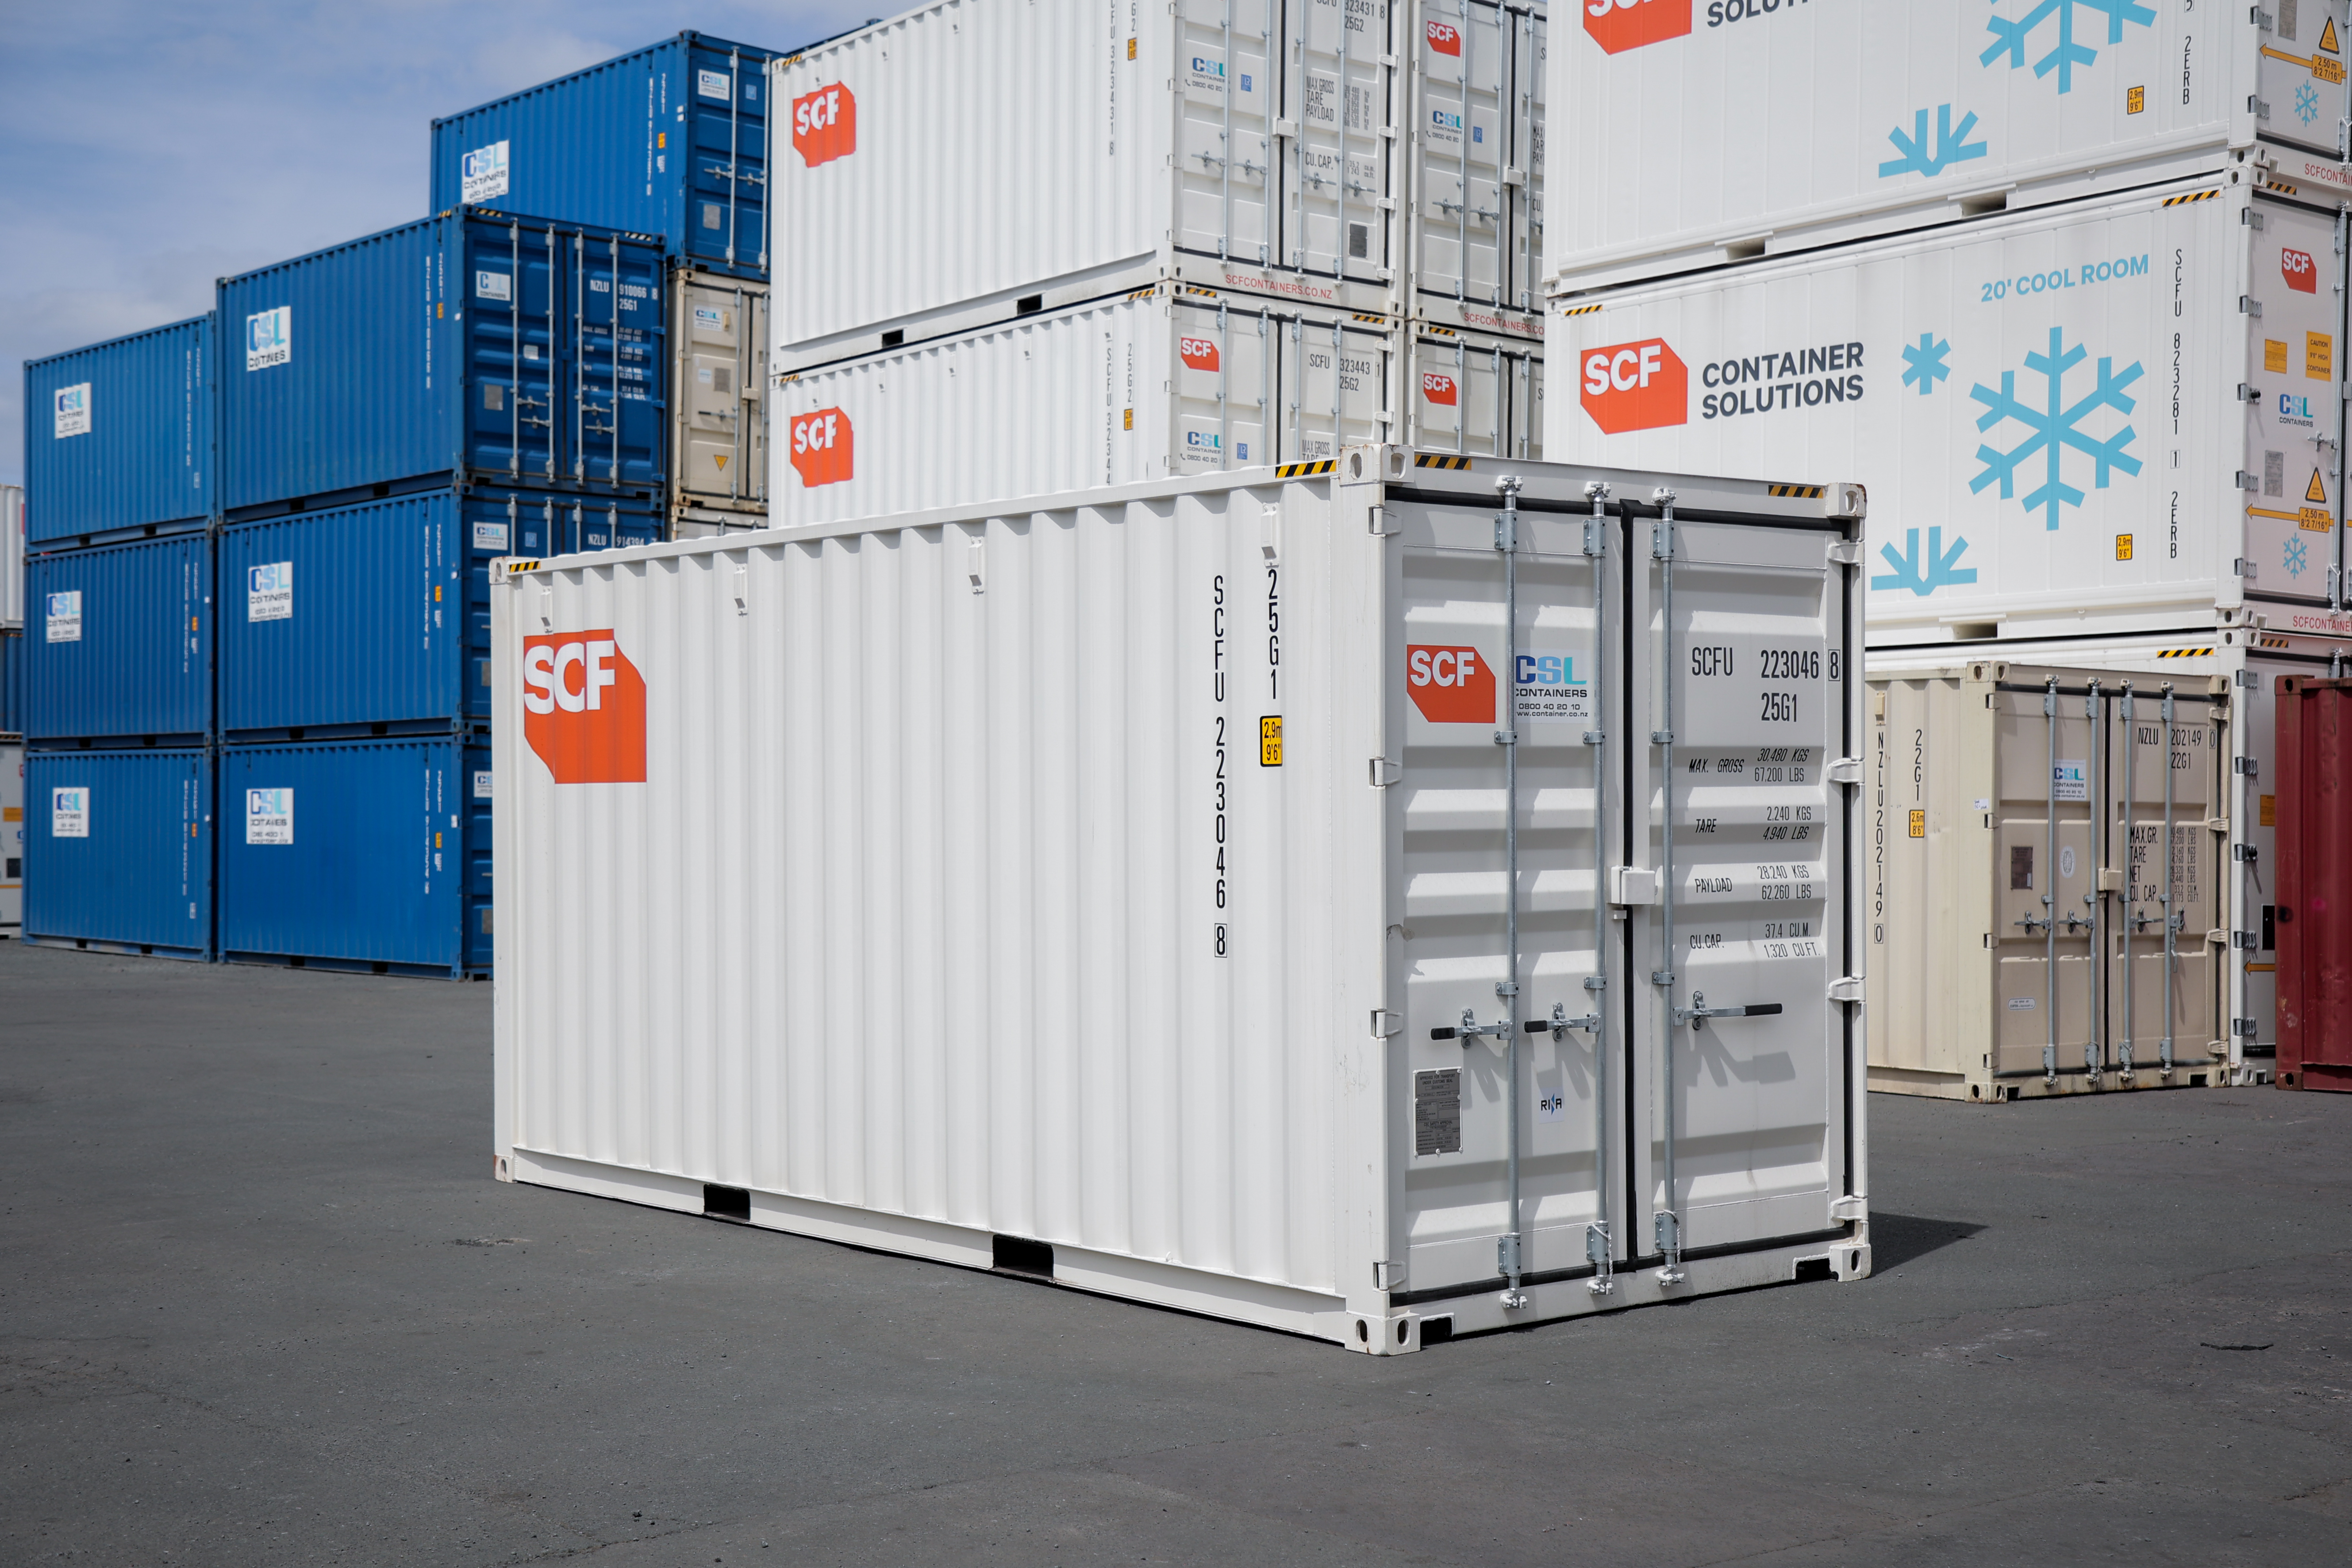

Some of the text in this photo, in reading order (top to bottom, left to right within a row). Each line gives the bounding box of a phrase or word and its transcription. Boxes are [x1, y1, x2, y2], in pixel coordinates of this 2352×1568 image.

[1345, 0, 1375, 17] 323431
[1380, 5, 1385, 19] 8
[1345, 15, 1364, 32] 25G2
[1428, 23, 1454, 42] SCF
[1192, 57, 1225, 77] CSL
[2183, 35, 2192, 105] 2ERB
[1307, 75, 1334, 95] MAX GROSS
[1307, 89, 1323, 106] TARE
[2129, 90, 2143, 101] 2,9m
[796, 90, 839, 136] SCF
[1306, 104, 1334, 122] PAYLOAD
[1433, 111, 1462, 129] CSL
[465, 146, 506, 177] CSL
[1306, 152, 1334, 170] CU. CAP.
[2283, 251, 2310, 274] SCF
[1226, 274, 1332, 300] SCFCONTAINERS.CO.NZ
[1981, 254, 2149, 303] 20' COOL ROOM
[590, 279, 658, 300] NZLU 910066 8
[619, 299, 638, 311] 25G1
[250, 312, 285, 351] CSL
[1181, 339, 1212, 357] SCF
[2310, 339, 2329, 348] CAUTION
[1310, 354, 1330, 369] SCFU
[1340, 358, 1370, 375] 323443
[1584, 345, 1661, 396] SCF
[1702, 342, 1864, 388] CONTAINER
[2307, 365, 2330, 375] CONTAINER
[1340, 376, 1359, 392] 25G2
[1424, 375, 1450, 392] SCF
[2172, 332, 2181, 435] 823281
[1702, 374, 1864, 419] SOLUTIONS
[2279, 394, 2314, 418] CSL
[2279, 417, 2314, 428] CONTAINERS
[794, 413, 837, 455] SCF
[1188, 431, 1221, 449] CSL
[1302, 439, 1330, 456] MAX GROSS
[588, 534, 645, 547] NZLU 914394
[2118, 537, 2131, 548] 2,9m
[251, 564, 290, 592] CSL
[1268, 569, 1279, 700] 25G1
[1410, 650, 1475, 687] SCF
[1516, 655, 1587, 685] CSL
[1691, 646, 1839, 680] SCFU 223046 8
[524, 640, 616, 715] SCF
[1760, 692, 1798, 722] 25G1
[1264, 721, 1282, 742] 2,9m
[2138, 727, 2159, 745] NZLU
[2171, 729, 2202, 747] 202149
[1757, 748, 1810, 762] 30,480 KGS
[2171, 752, 2191, 769] 22G1
[1214, 575, 1226, 957] SCFU 223046 8
[1689, 758, 1745, 773] MAX. GROSS
[1914, 729, 1922, 801] 22G1
[2054, 768, 2084, 780] CSL
[1754, 767, 1805, 783] 67,200 LBS
[251, 790, 287, 815] CSL
[1766, 806, 1812, 822] 2,240 KGS
[1695, 819, 1717, 834] TARE
[1762, 826, 1809, 841] 4,940 LBS
[2130, 826, 2158, 844] MAX.GR.
[2130, 846, 2146, 863] TARE
[1756, 865, 1810, 880] 28,240 KGS
[2130, 865, 2141, 883] NET
[1695, 877, 1733, 893] PAYLOAD
[1761, 884, 1812, 901] 62,260 LBS
[2130, 885, 2158, 902] CU. CAP.
[1765, 923, 1811, 939] 37.4 CU.M.
[1689, 934, 1725, 950] CU.CAP.
[1763, 942, 1821, 959] 1,320 CU.FT.
